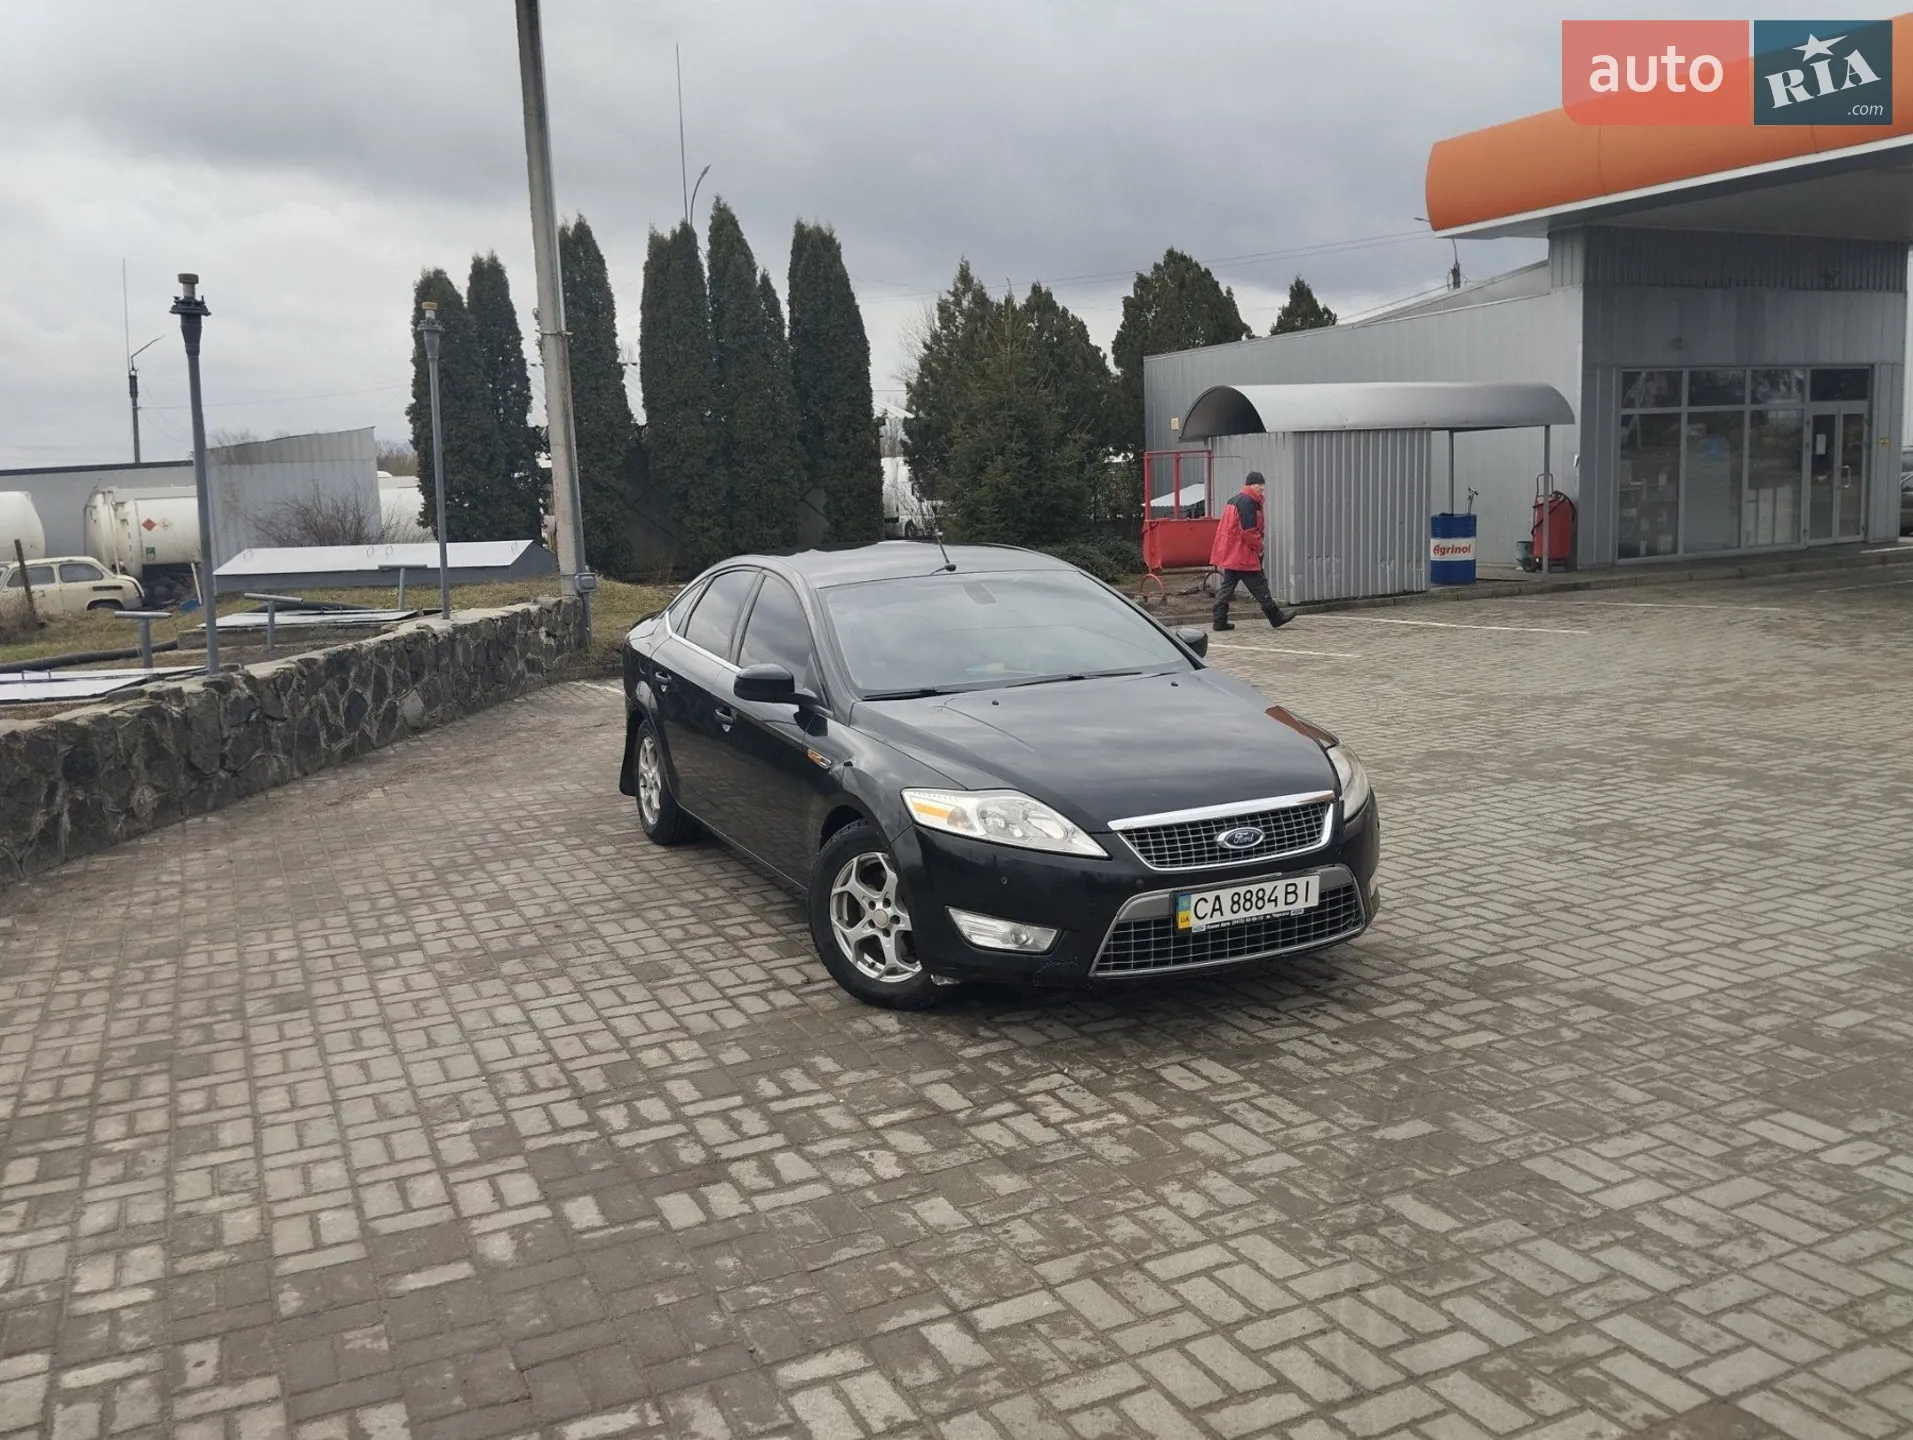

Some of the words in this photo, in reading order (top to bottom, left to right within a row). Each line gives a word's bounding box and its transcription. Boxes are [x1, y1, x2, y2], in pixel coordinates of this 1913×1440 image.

[1433, 544, 1472, 555] Agrinol
[1233, 832, 1254, 844] Ford
[1194, 895, 1224, 920] CA
[1230, 885, 1278, 914] 8884
[1284, 881, 1310, 906] BI
